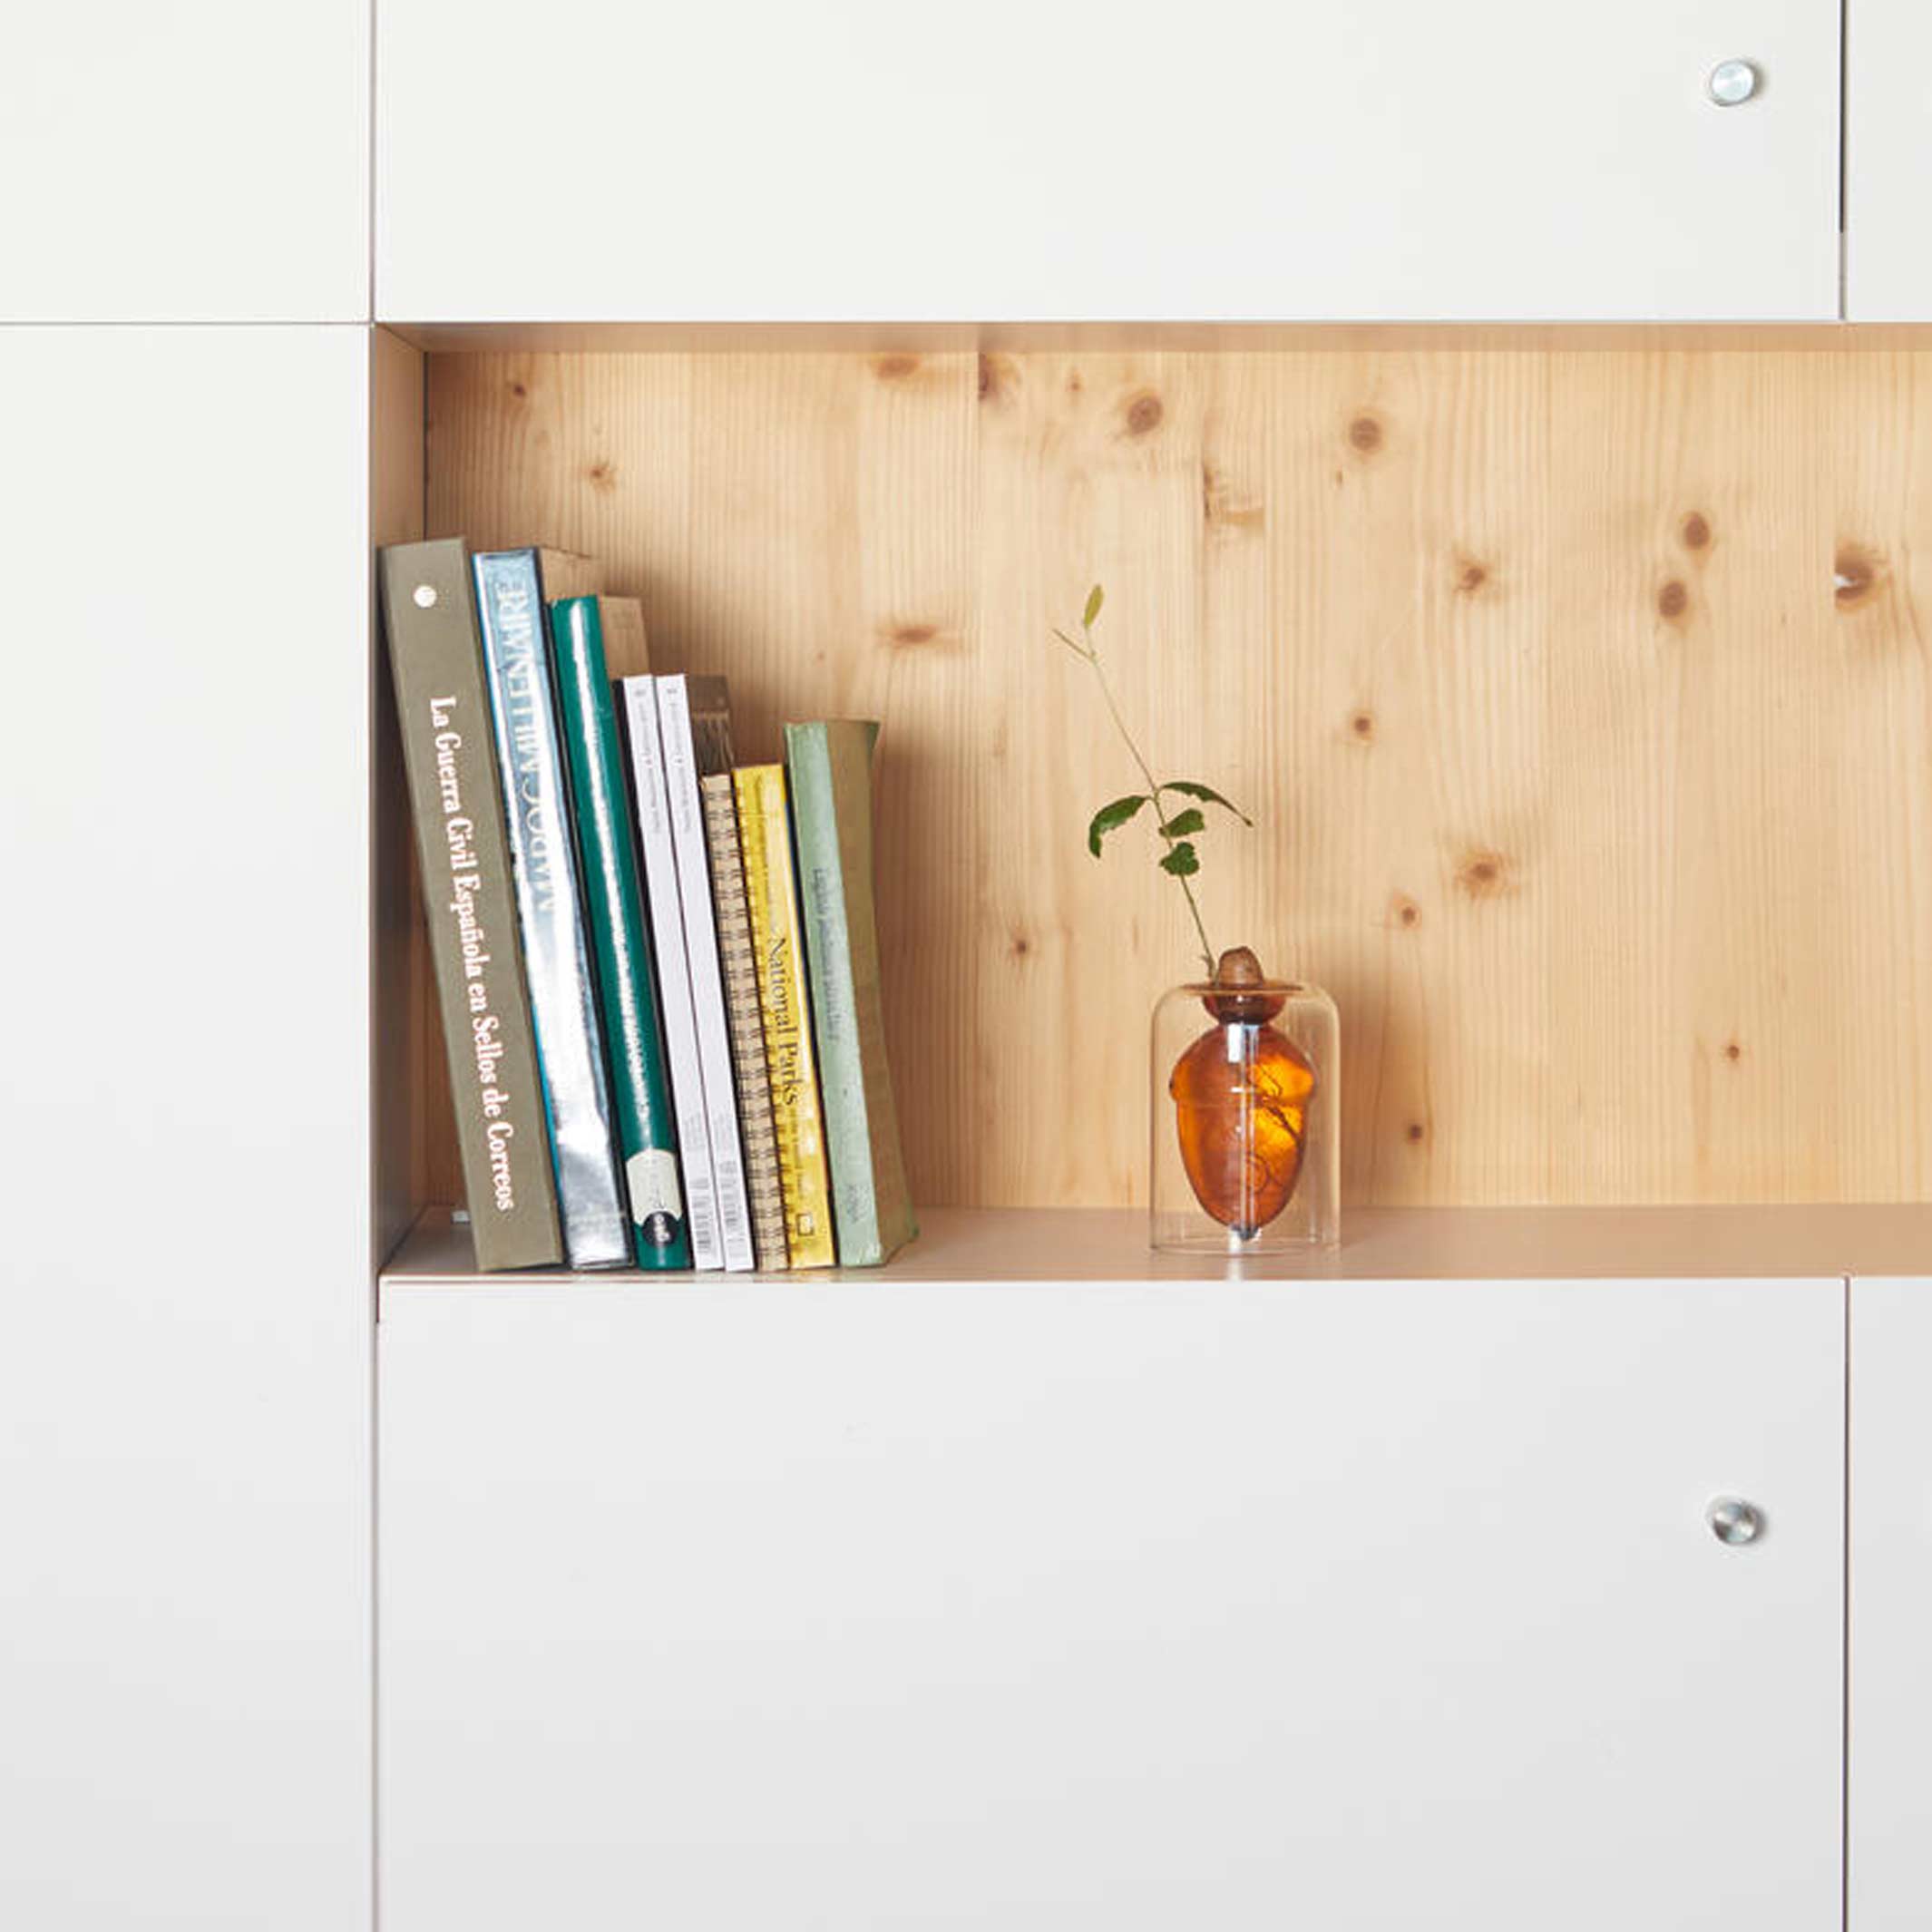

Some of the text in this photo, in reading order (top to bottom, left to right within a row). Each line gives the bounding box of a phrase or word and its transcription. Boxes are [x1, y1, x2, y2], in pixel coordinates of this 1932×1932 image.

[430, 696, 514, 1211] La Guerra Civil Española en Sellos de Correos
[768, 937, 798, 1034] National
[778, 1042, 805, 1106] Parks
